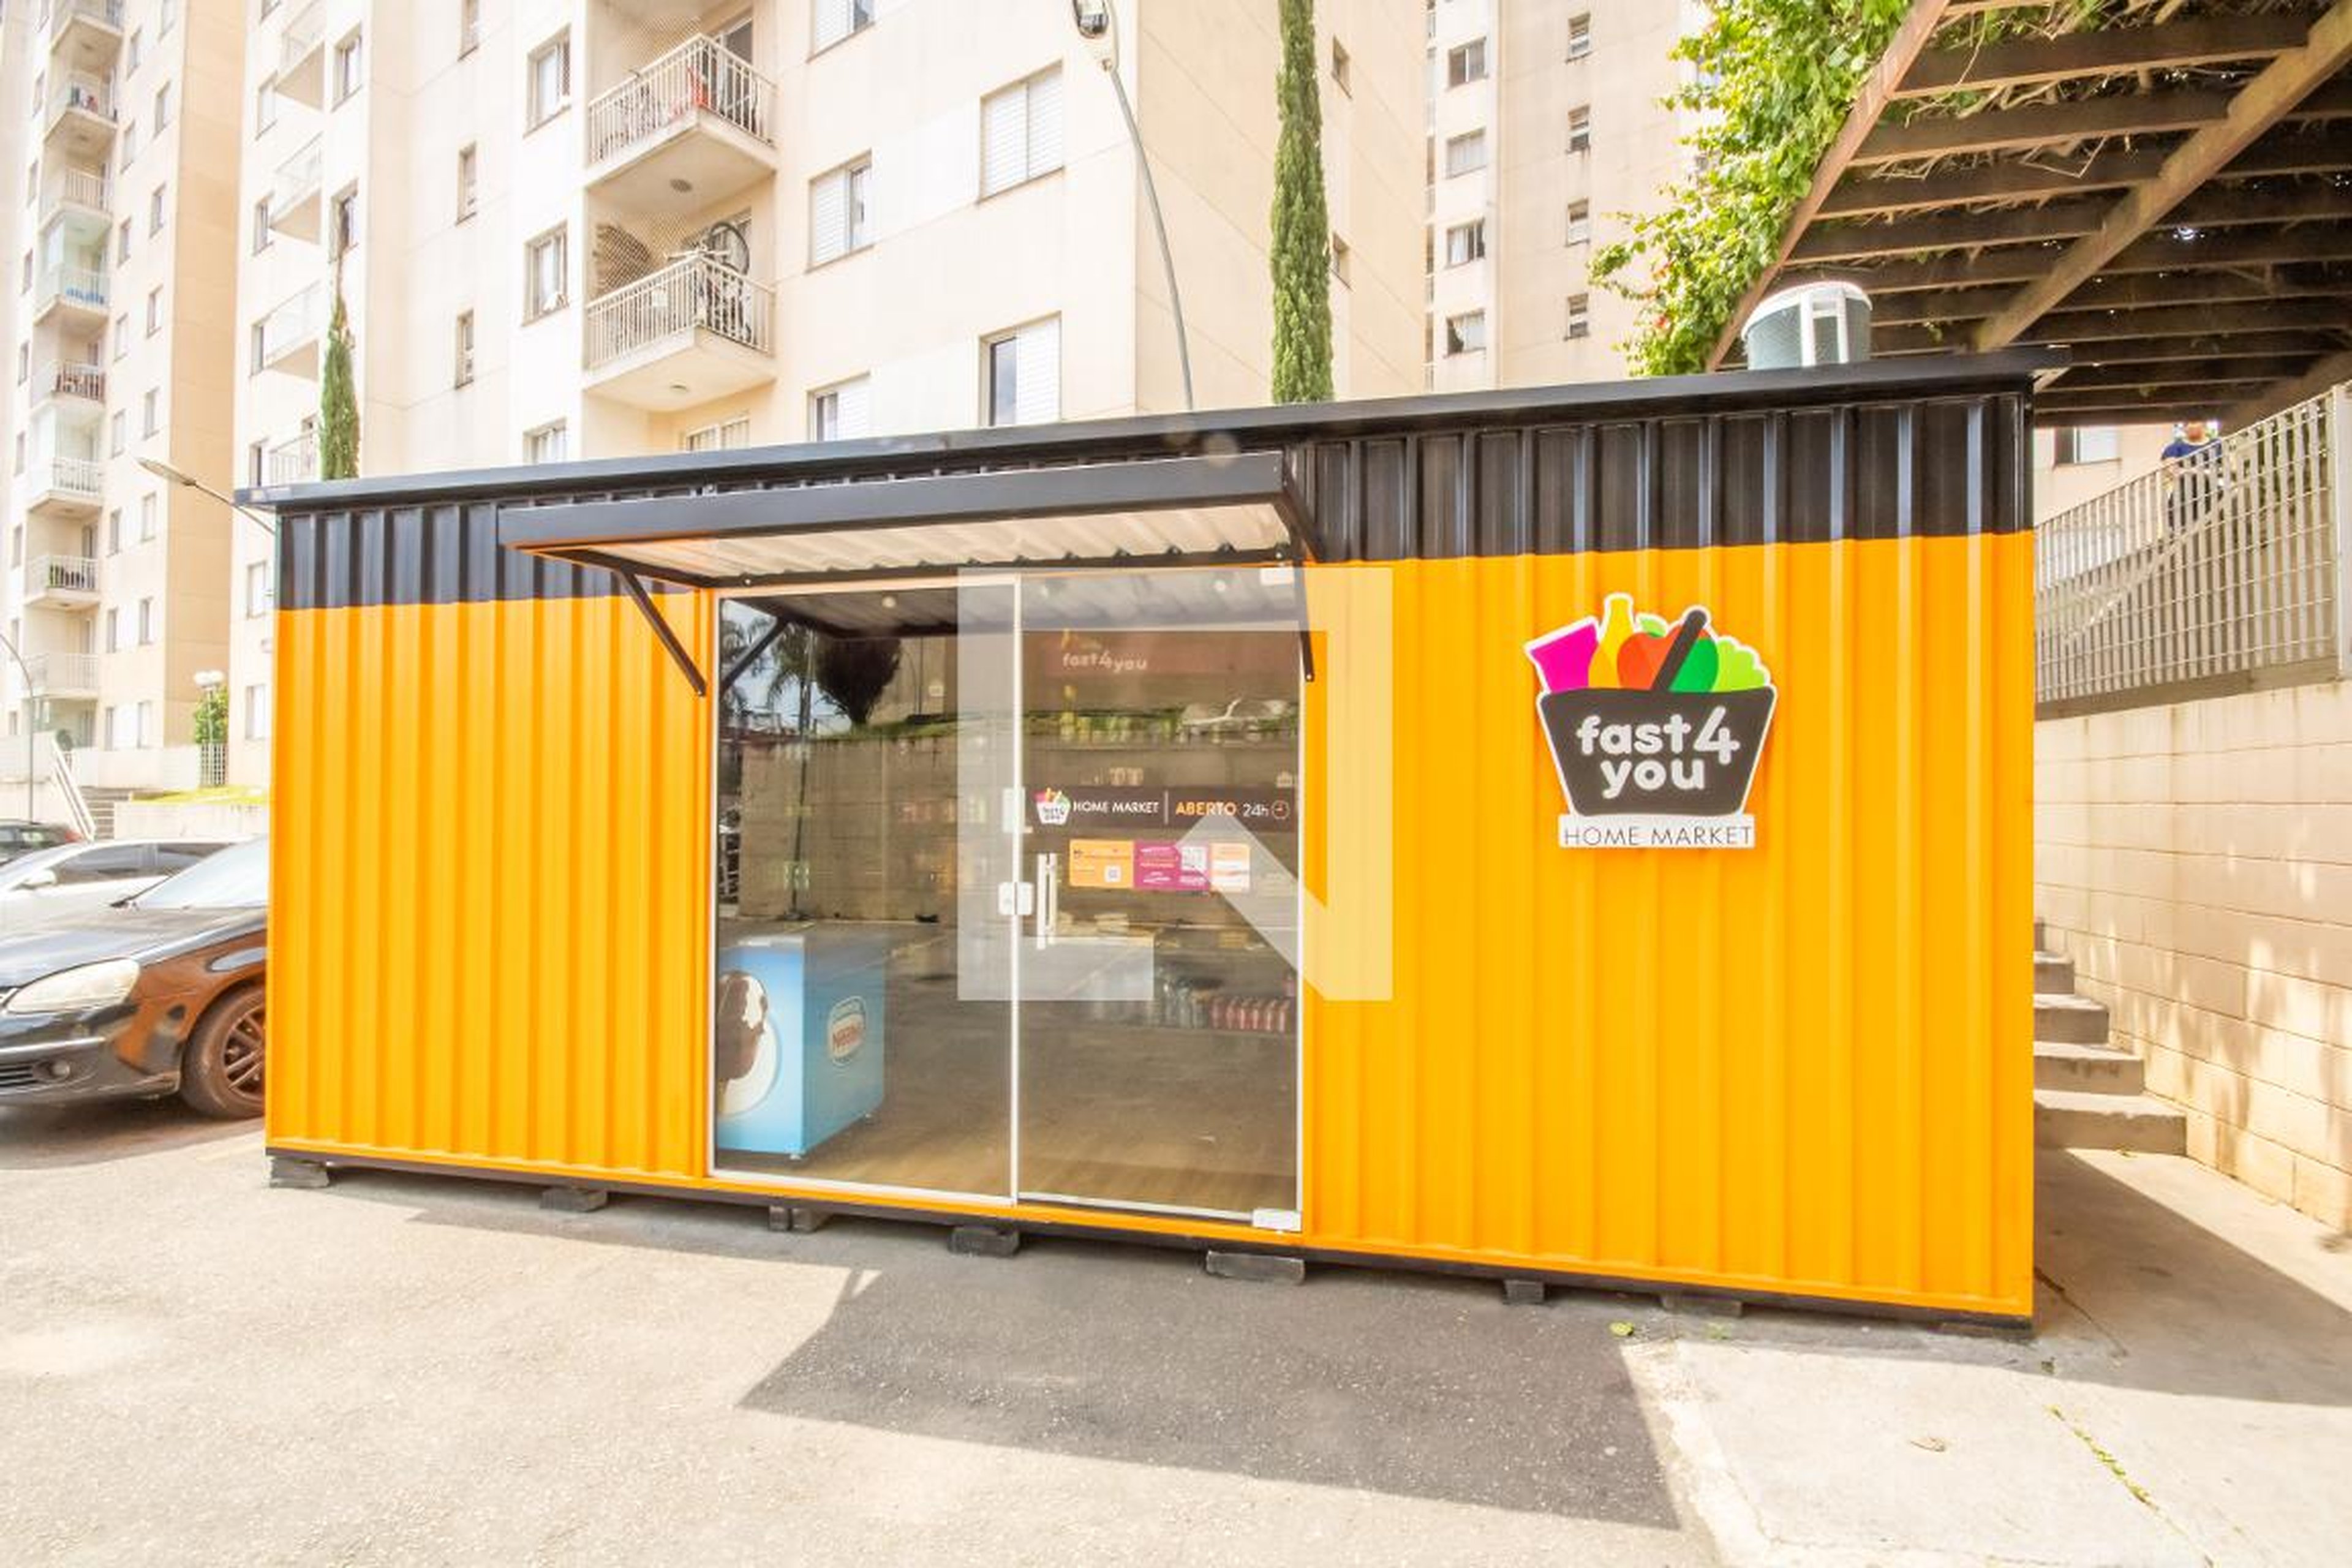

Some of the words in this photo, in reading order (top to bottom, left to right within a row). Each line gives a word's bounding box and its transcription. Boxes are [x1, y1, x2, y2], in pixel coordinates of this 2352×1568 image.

[1600, 759, 1705, 799] you
[1072, 801, 1108, 813] HOME
[1112, 801, 1159, 814] MARKET
[1175, 801, 1237, 816] ABERTO
[1243, 802, 1268, 817] 24h
[1564, 826, 1640, 846] HOME
[1651, 826, 1751, 846] MARKET
